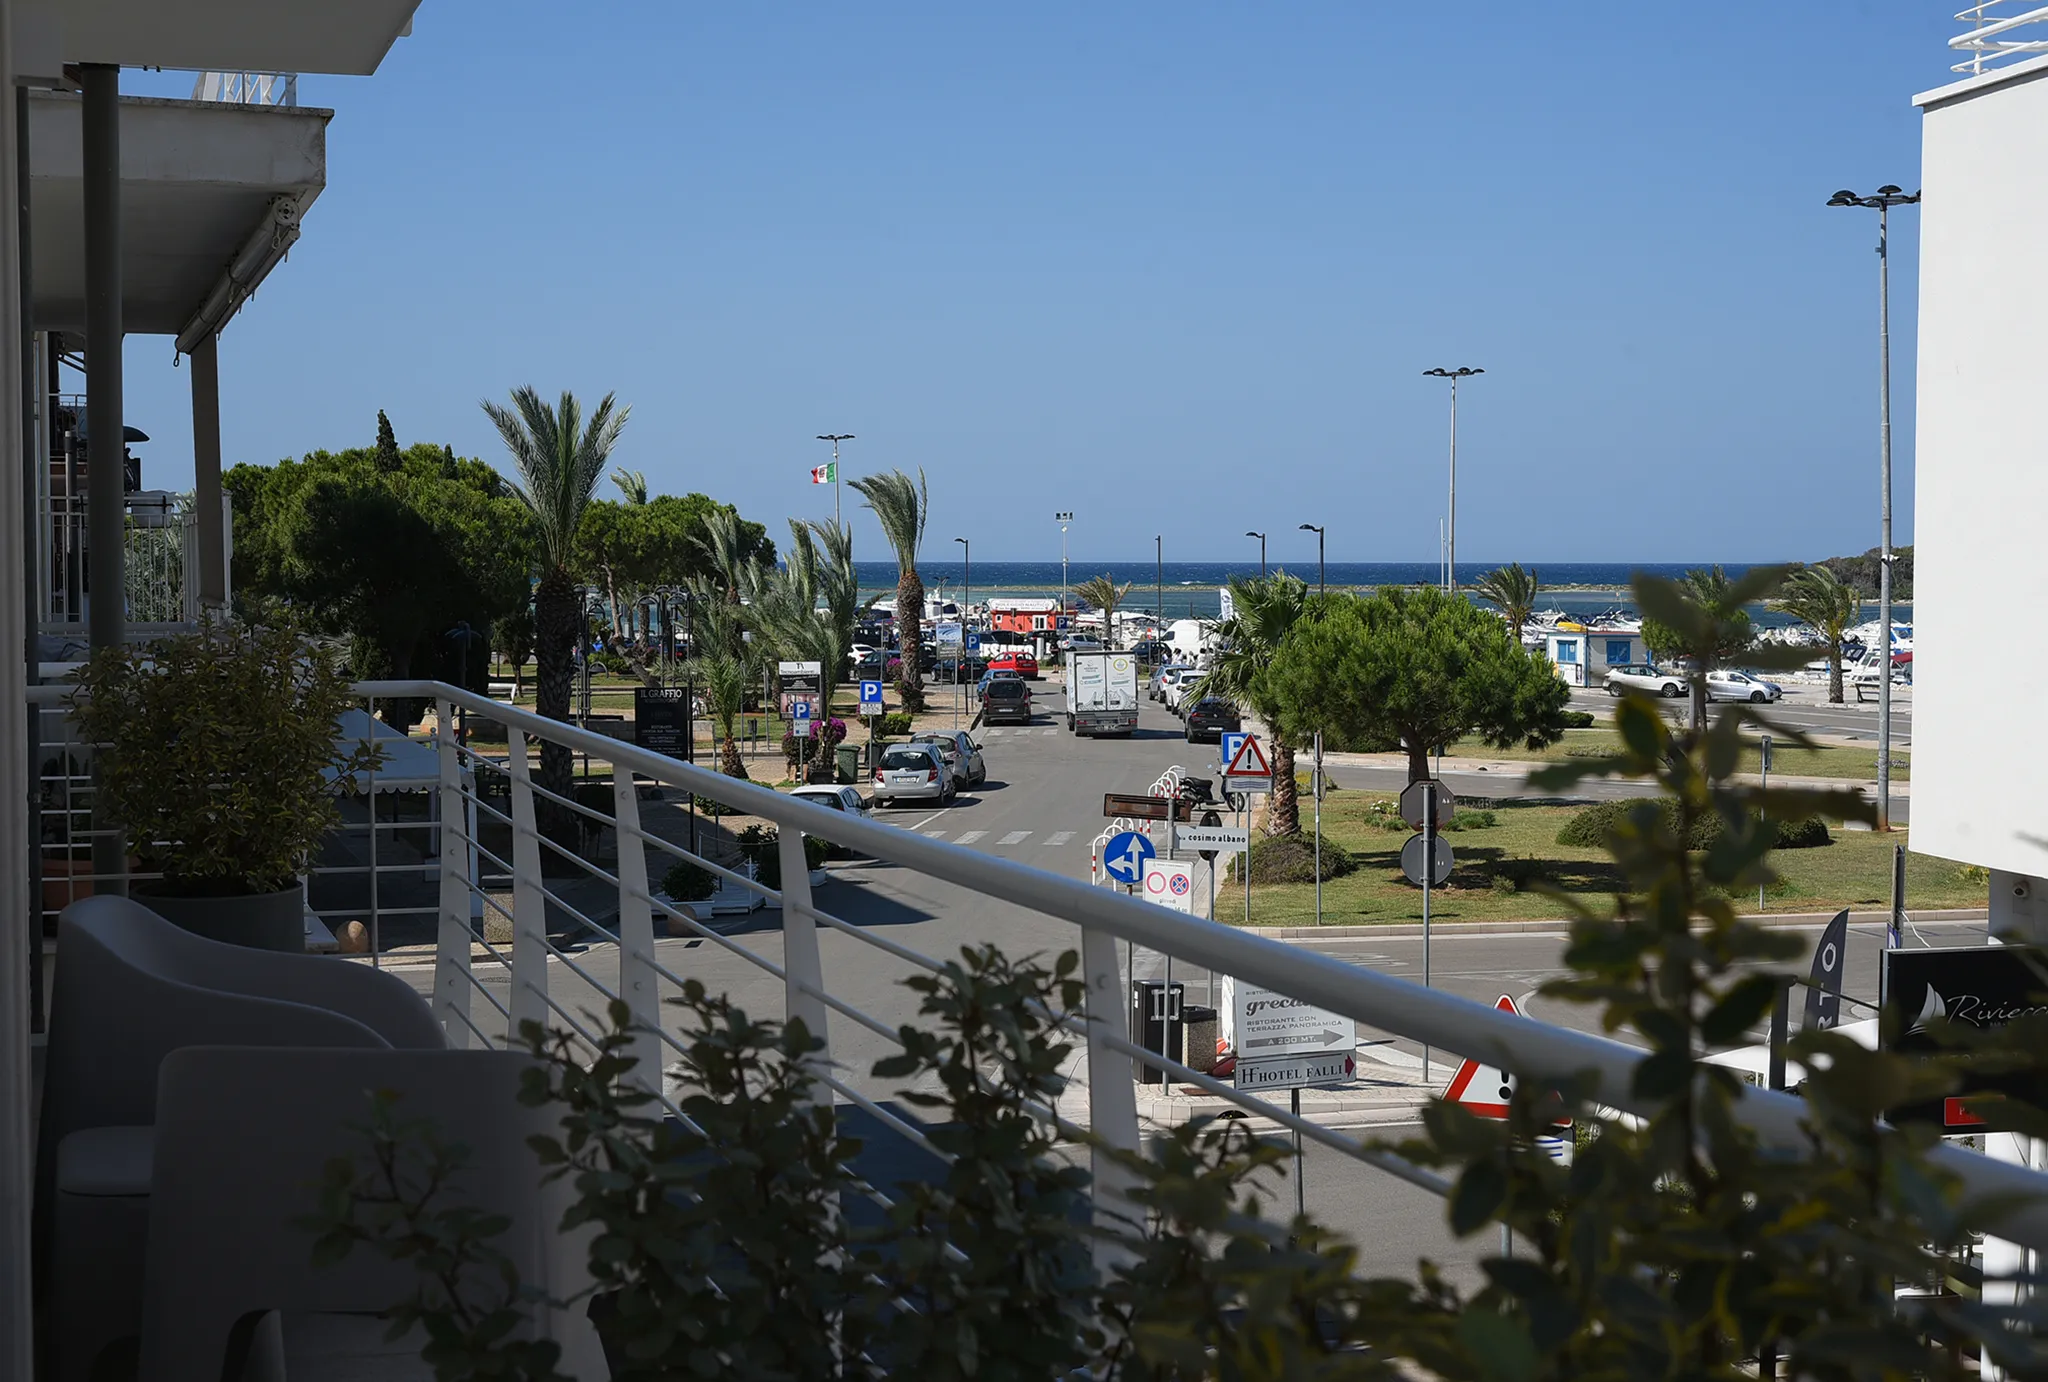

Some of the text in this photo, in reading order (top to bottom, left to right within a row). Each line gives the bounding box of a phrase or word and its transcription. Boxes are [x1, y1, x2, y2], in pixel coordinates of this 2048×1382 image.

[1059, 618, 1065, 628] P
[968, 636, 977, 648] P
[640, 689, 683, 698] IL GRAFFIO
[864, 683, 878, 701] P
[796, 703, 807, 718] P
[1188, 834, 1216, 842] cosimo
[1218, 834, 1246, 843] albano
[1246, 1016, 1296, 1027] RISTORANTE
[1246, 1020, 1343, 1033] TERRAZZA PANORAMICA
[1278, 1037, 1298, 1045] 200
[1259, 1068, 1303, 1082] HOTEL
[1306, 1065, 1342, 1078] FALLI
